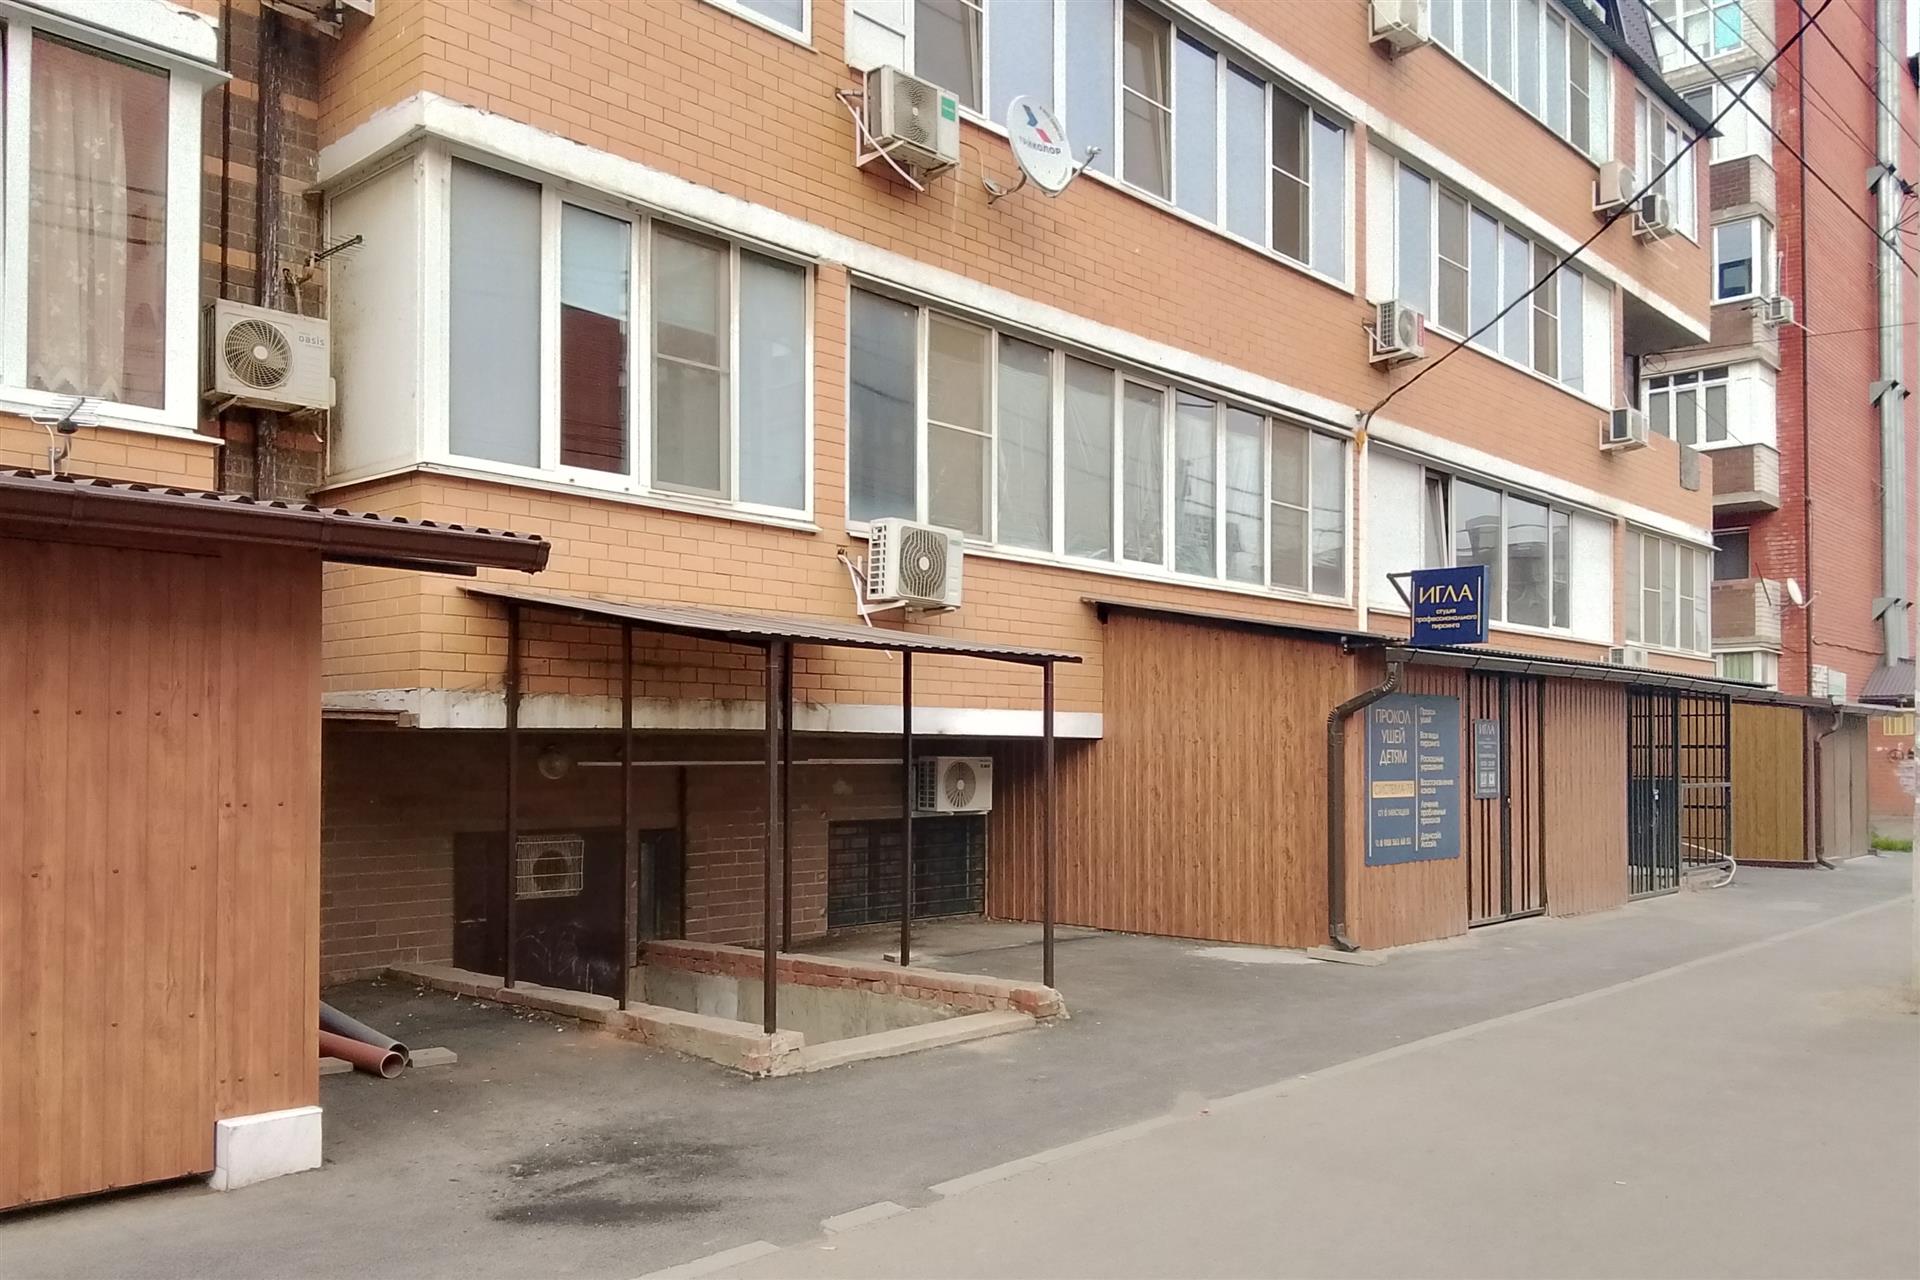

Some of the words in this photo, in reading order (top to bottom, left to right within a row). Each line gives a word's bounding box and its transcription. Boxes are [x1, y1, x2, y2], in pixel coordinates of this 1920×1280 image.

[299, 335, 325, 346] oasis
[1419, 584, 1473, 604] ИГЛА
[1415, 615, 1477, 623] профессионального
[1375, 709, 1411, 724] ПРОКОЛ
[1381, 727, 1406, 744] УШЕЙ
[1379, 749, 1408, 766] ДЕТЯМ
